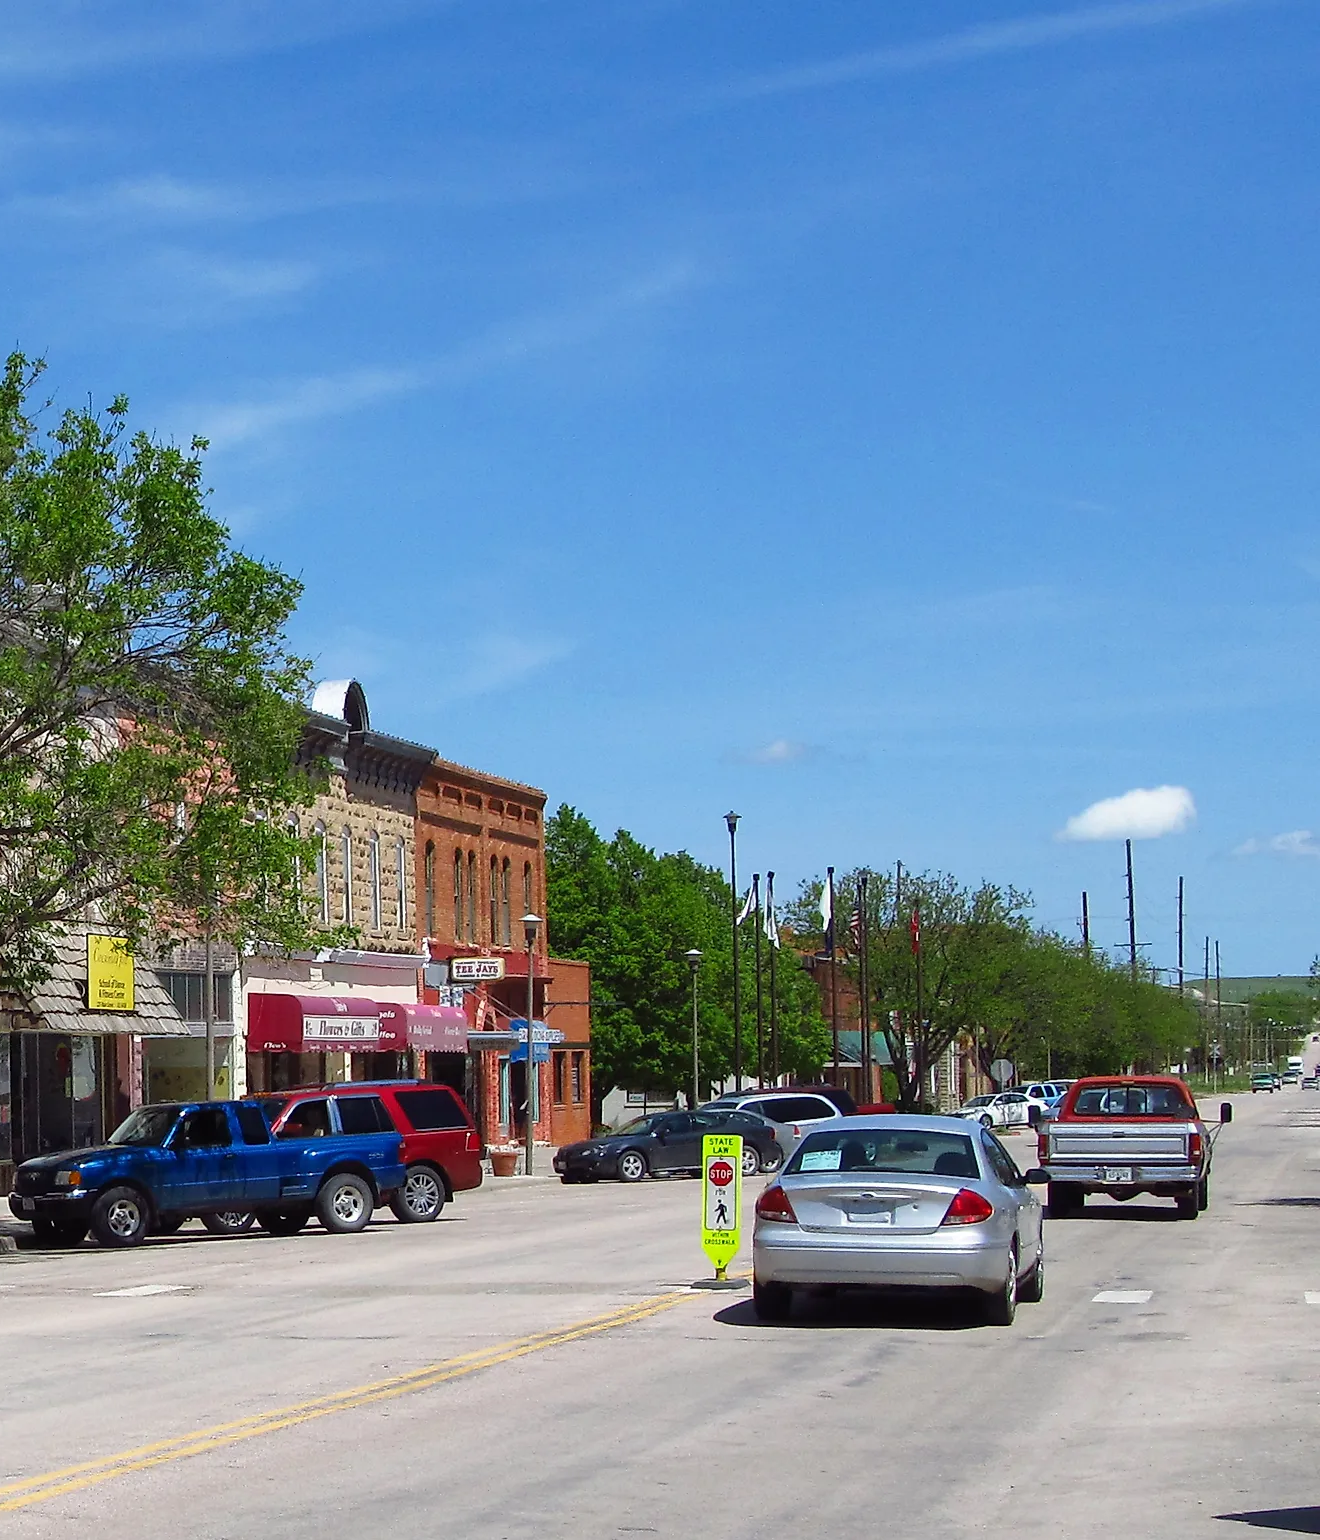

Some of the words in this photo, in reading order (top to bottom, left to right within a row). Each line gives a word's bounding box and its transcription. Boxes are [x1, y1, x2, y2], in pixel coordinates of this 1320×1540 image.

[455, 965, 473, 974] TEE
[709, 1138, 734, 1146] STATE
[713, 1146, 729, 1154] LAW
[710, 1168, 733, 1179] STOP
